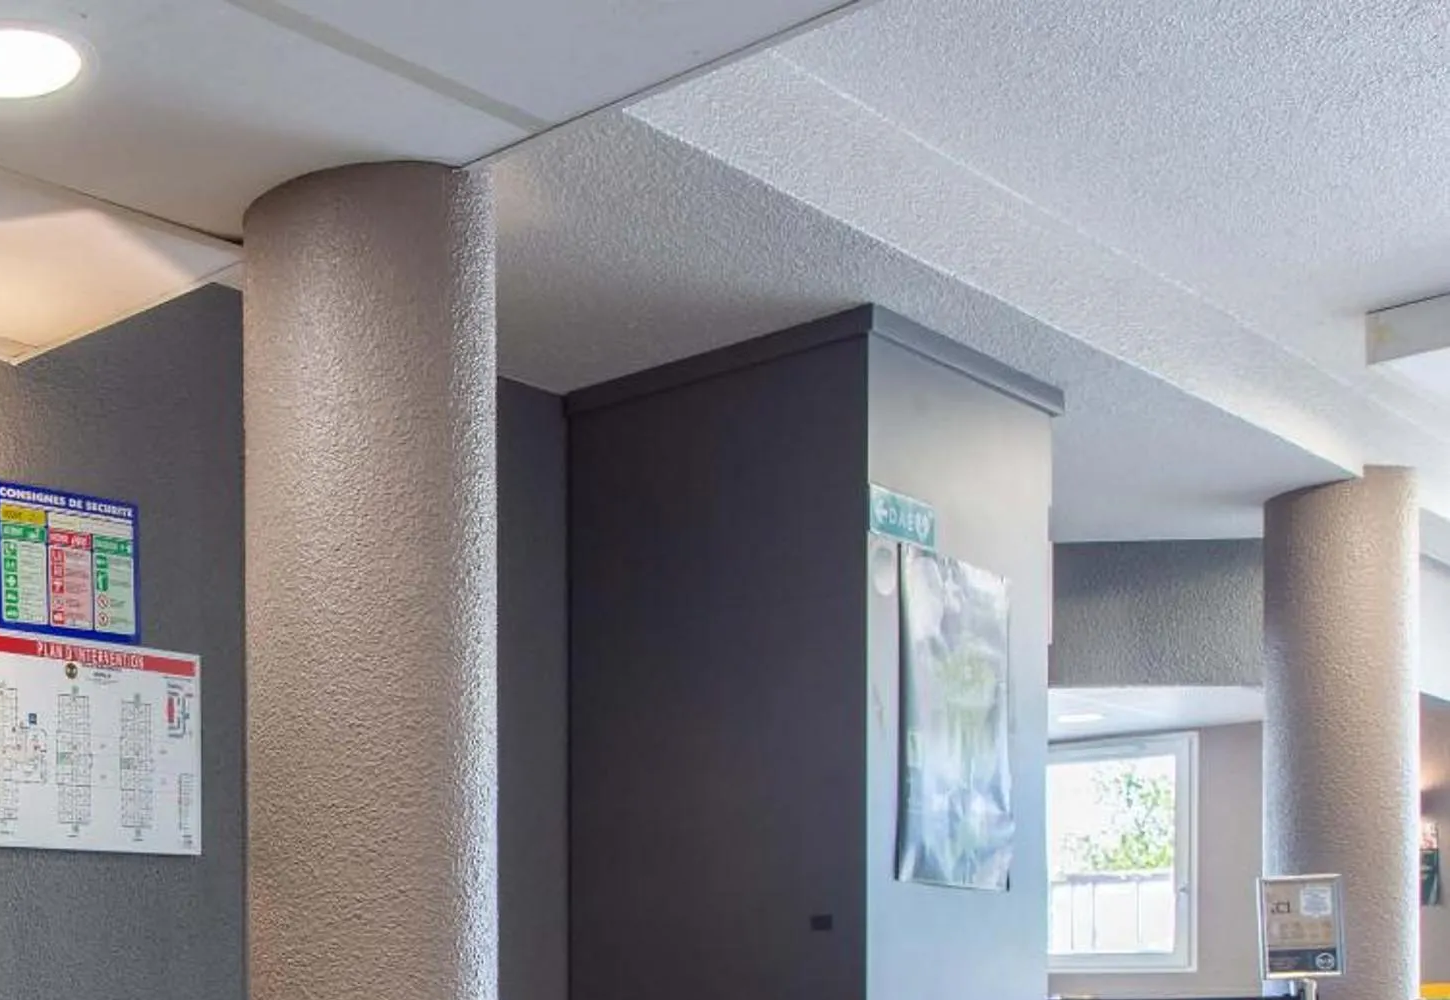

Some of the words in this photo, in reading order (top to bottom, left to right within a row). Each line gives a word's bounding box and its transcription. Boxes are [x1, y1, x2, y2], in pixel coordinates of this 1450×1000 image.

[68, 496, 83, 509] DE
[889, 507, 914, 532] DAE
[36, 640, 63, 660] PLAN
